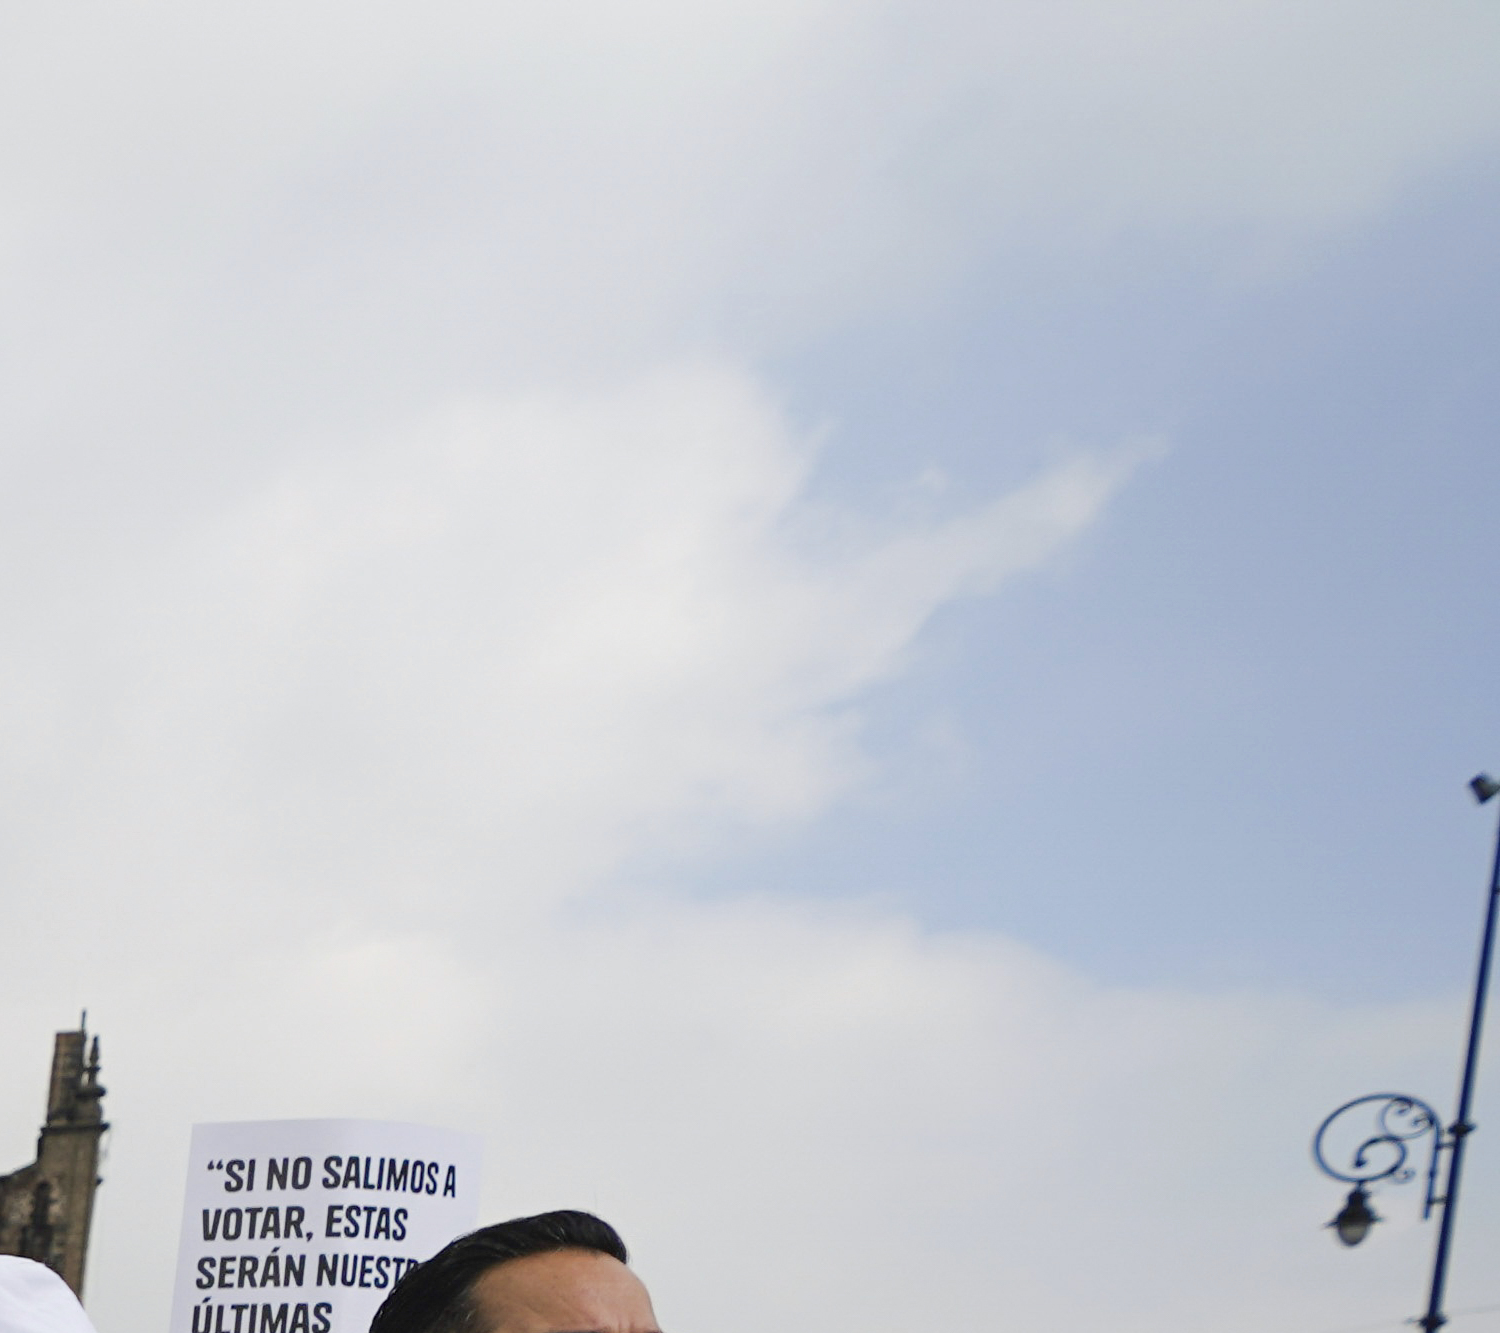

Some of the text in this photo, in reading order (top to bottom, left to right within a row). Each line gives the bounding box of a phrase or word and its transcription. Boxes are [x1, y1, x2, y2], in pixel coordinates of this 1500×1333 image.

[266, 1156, 312, 1191] NO
[322, 1155, 439, 1196] SALIMOS
[443, 1165, 457, 1198] A
[202, 1205, 408, 1242] VOTAR, ESTAS
[196, 1247, 306, 1289] SERÁN
